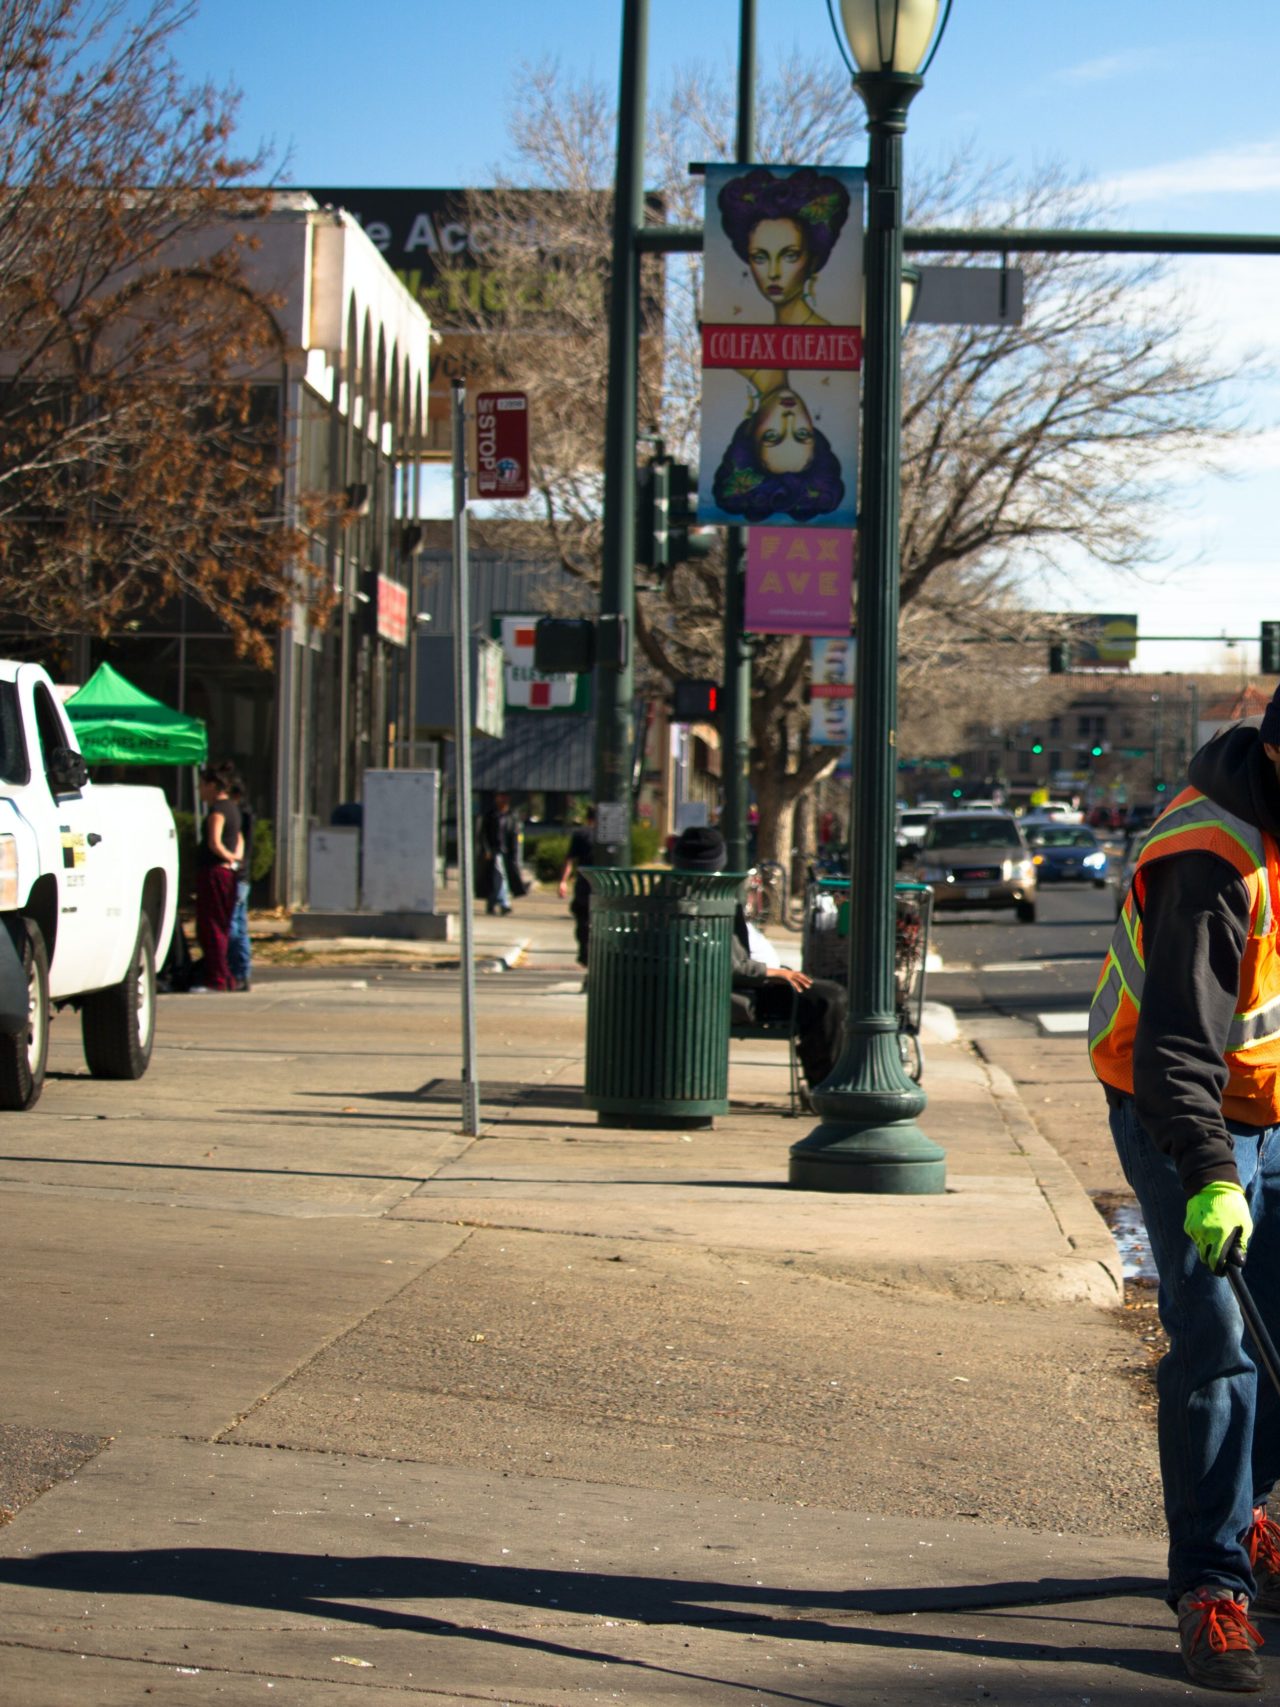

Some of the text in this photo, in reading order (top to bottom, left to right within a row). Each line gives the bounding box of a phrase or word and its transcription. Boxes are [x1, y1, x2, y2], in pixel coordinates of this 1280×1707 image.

[710, 332, 858, 361] COLFAX CREATES
[479, 415, 497, 470] STOP
[760, 535, 840, 562] FAX
[758, 570, 839, 597] AVE
